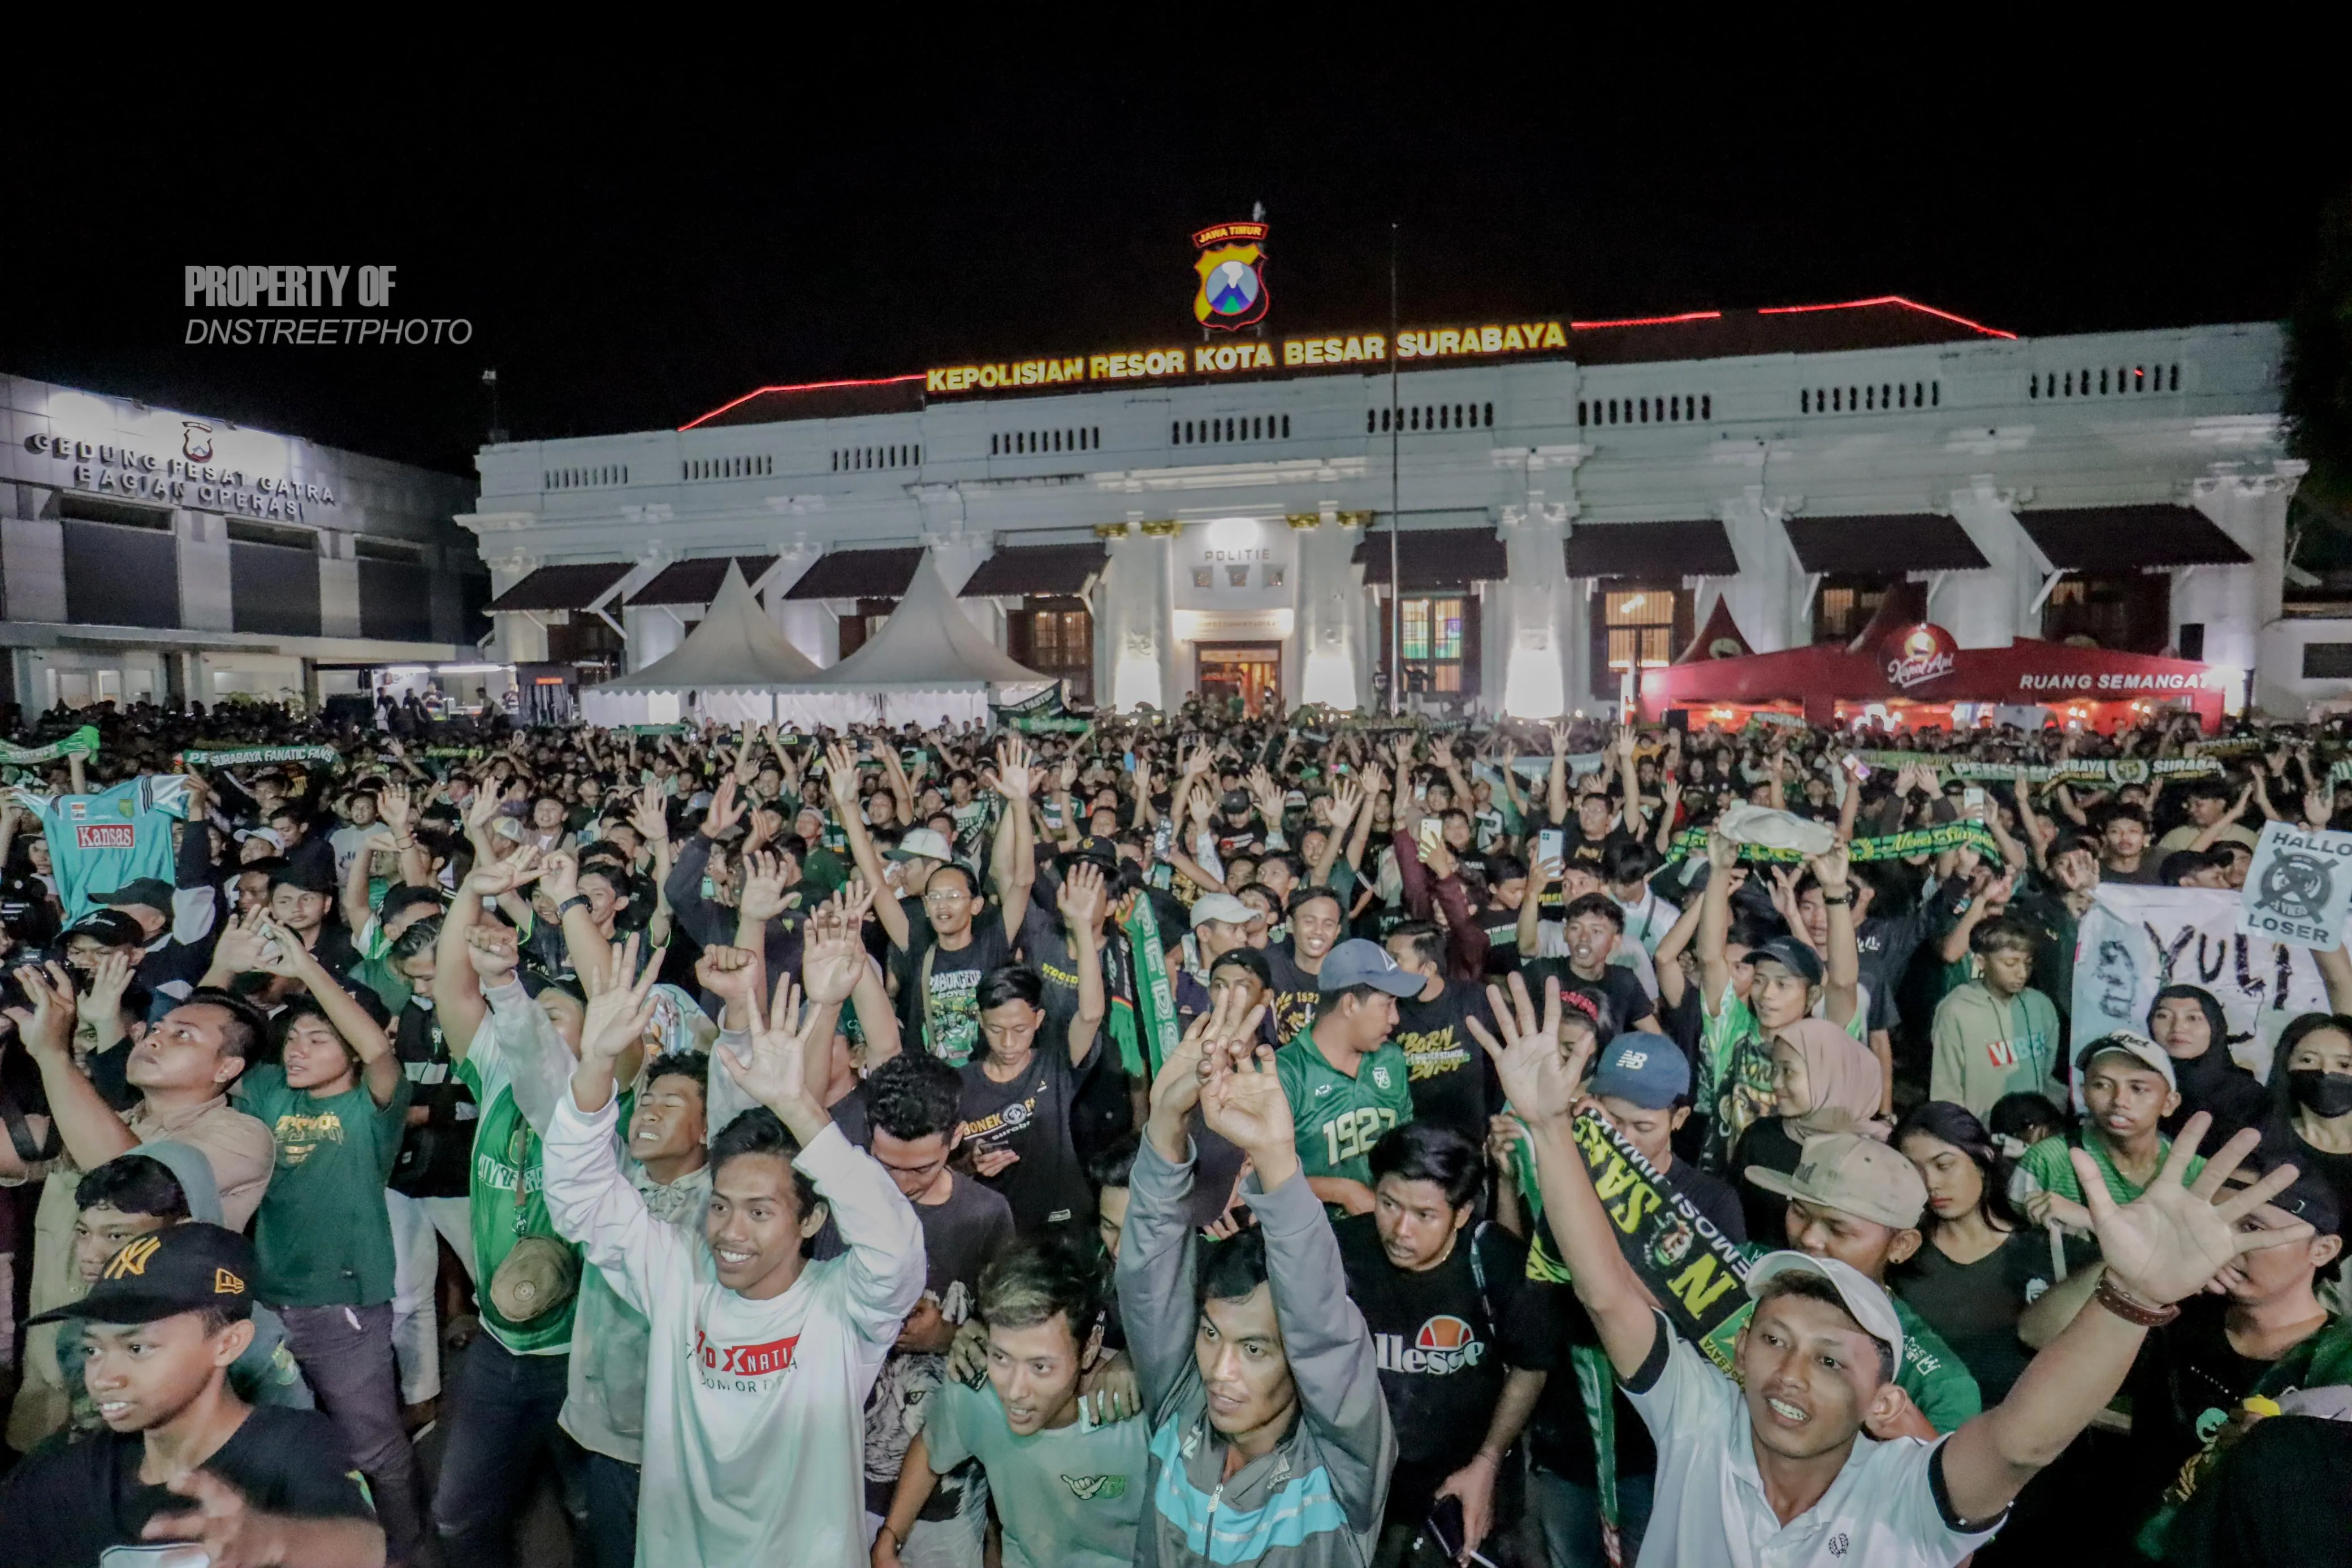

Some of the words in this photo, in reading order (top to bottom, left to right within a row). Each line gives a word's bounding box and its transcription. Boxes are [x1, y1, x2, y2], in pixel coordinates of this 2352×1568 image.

[1199, 228, 1227, 244] JAWA
[1229, 226, 1262, 236] TIMUR
[927, 357, 1084, 392] KEPOLISIAN
[1090, 350, 1186, 380] RESOR
[1195, 345, 1273, 372] KOTA
[1283, 335, 1385, 366] BESAR
[1396, 322, 1567, 357] SURABAYA
[28, 433, 157, 470] GEDUNG
[171, 458, 245, 486] PESAT
[260, 477, 336, 505] GATRA
[76, 465, 185, 497] BAGIAN
[199, 486, 304, 522] OPERASI
[1205, 549, 1270, 561] POLITIE
[2020, 673, 2092, 690] RUANG
[263, 748, 306, 762] FANATIC
[308, 747, 335, 763] FANS
[79, 826, 132, 847] Kansas
[2271, 831, 2352, 857] HALLO
[2247, 913, 2330, 944] LOSER
[963, 1112, 1004, 1136] BONEK
[1322, 1107, 1396, 1167] 1927
[1374, 1332, 1485, 1375] llesse
[735, 1380, 757, 1393] OR
